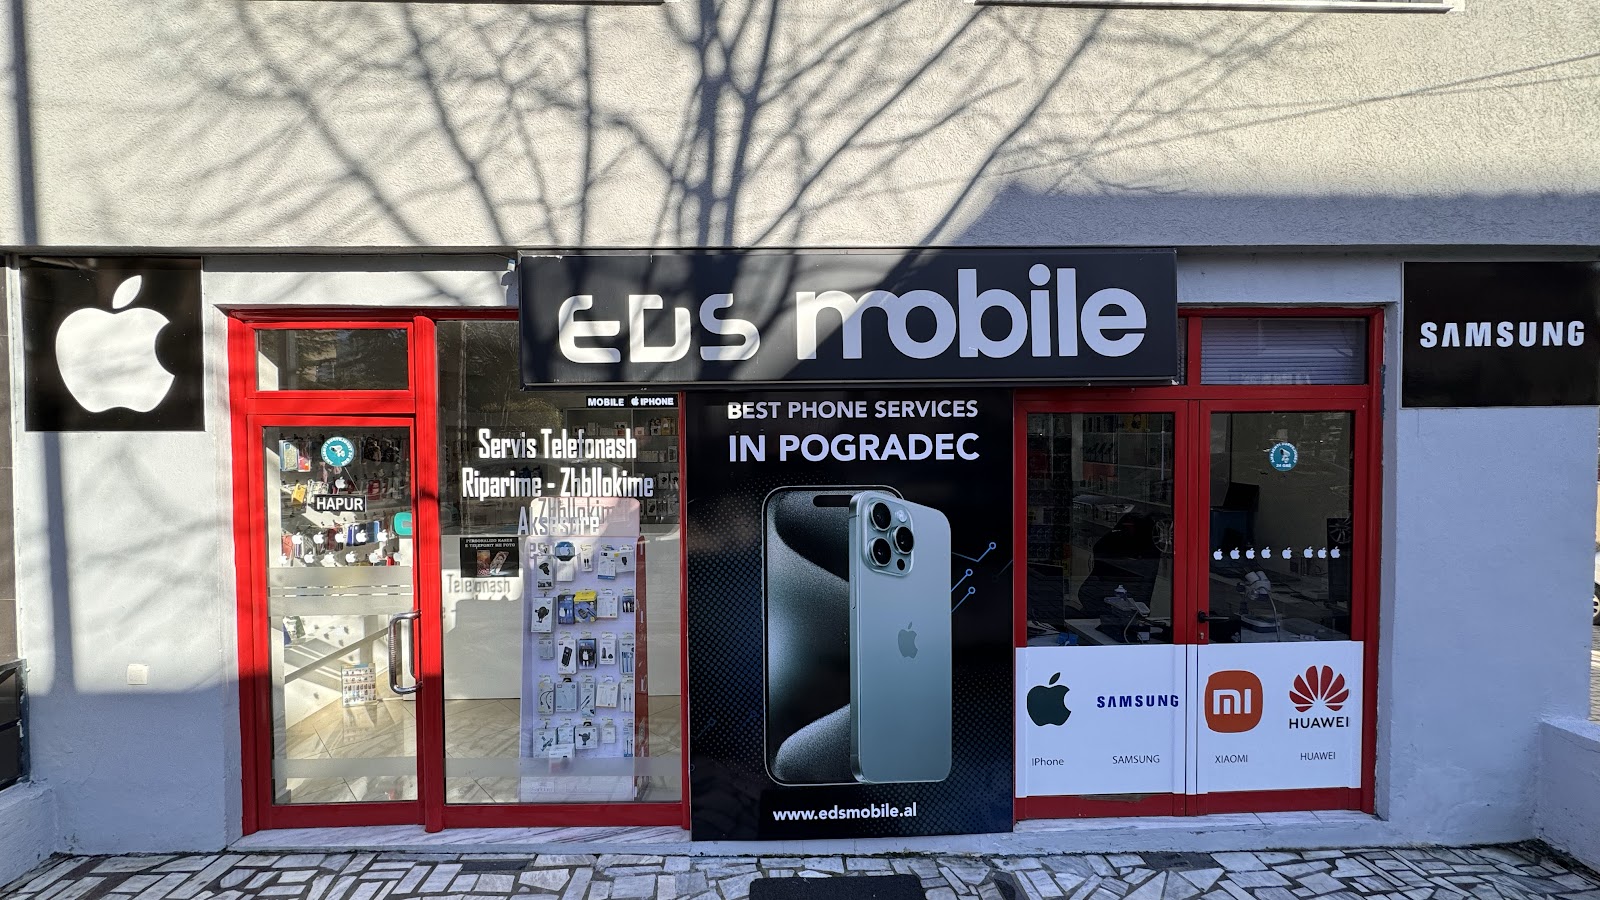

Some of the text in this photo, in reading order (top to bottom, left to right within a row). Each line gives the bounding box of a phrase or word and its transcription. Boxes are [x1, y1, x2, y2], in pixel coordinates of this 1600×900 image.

[558, 264, 1147, 364] EDS mobile
[1420, 321, 1585, 348] SAMSUNG
[587, 397, 674, 406] MOBILE IPHONE
[727, 400, 979, 420] BEST PHONE SERVICES
[478, 428, 637, 459] Servis Telefonash
[729, 433, 980, 462] IN POGRADEC
[462, 467, 542, 501] Riparime
[560, 467, 654, 497] Zhbllokime
[316, 497, 364, 511] HAPUR
[517, 506, 600, 536] Aksesore
[1096, 694, 1179, 708] SAMSUNG
[1289, 715, 1349, 729] HUAWEI
[1112, 754, 1160, 764] SAMSUNG
[1214, 754, 1248, 763] XIAOMI
[1300, 751, 1336, 761] HUAWEI
[773, 802, 917, 820] www.edsmobile.al
